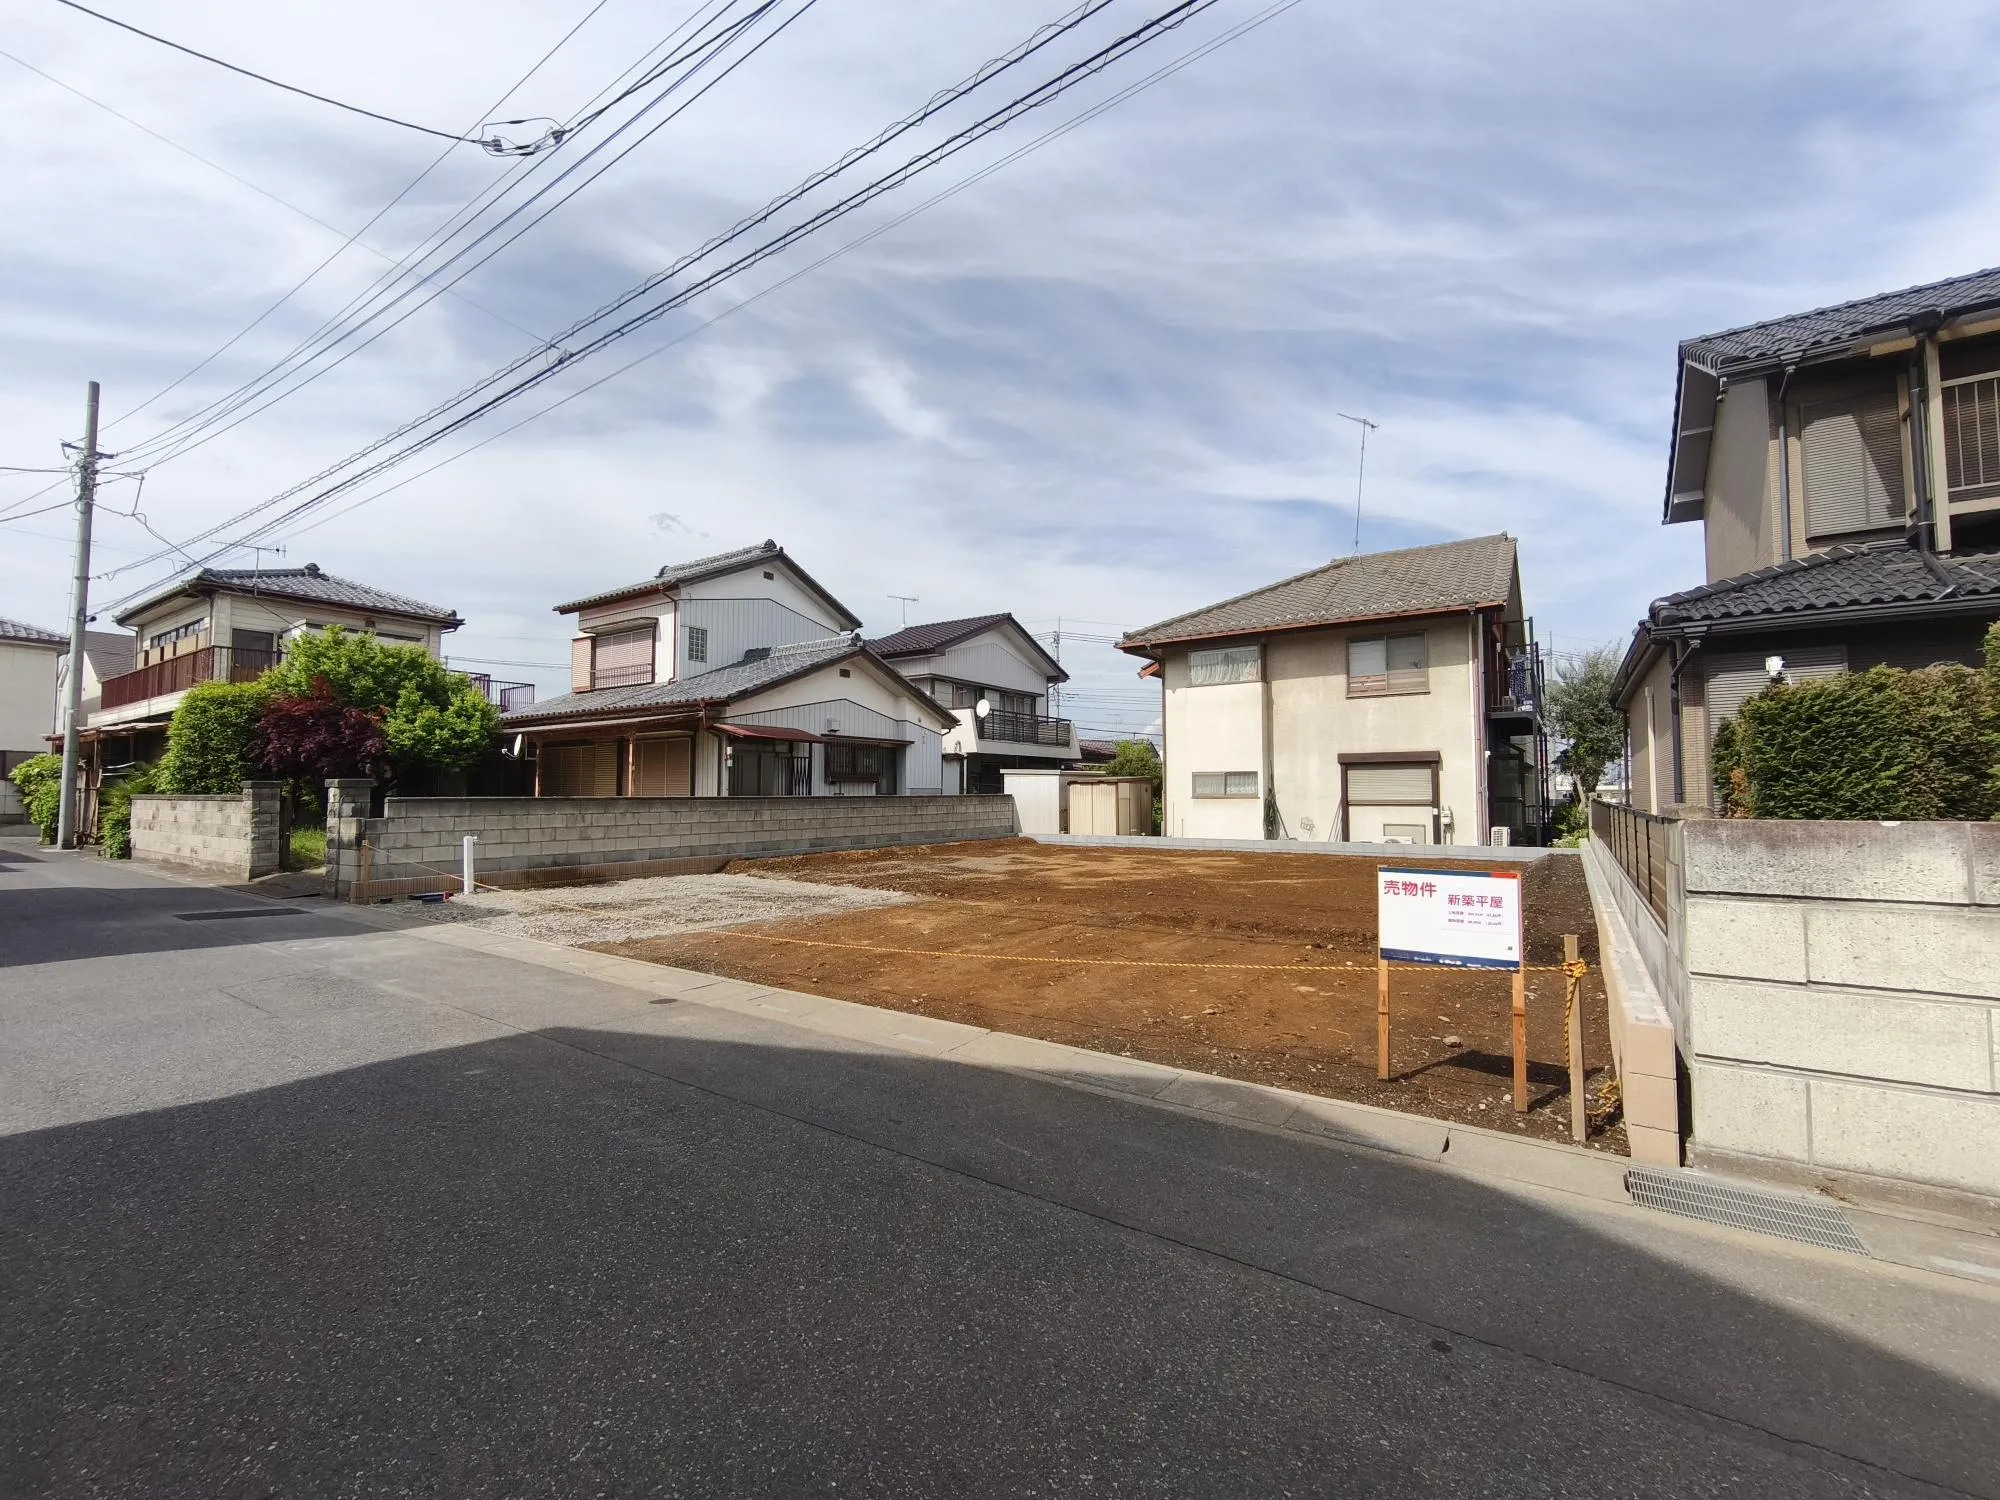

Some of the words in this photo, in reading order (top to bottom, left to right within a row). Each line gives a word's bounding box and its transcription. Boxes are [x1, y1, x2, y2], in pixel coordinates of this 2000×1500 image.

[1383, 879, 1437, 898] 売物件
[1447, 894, 1504, 909] 新築平屋
